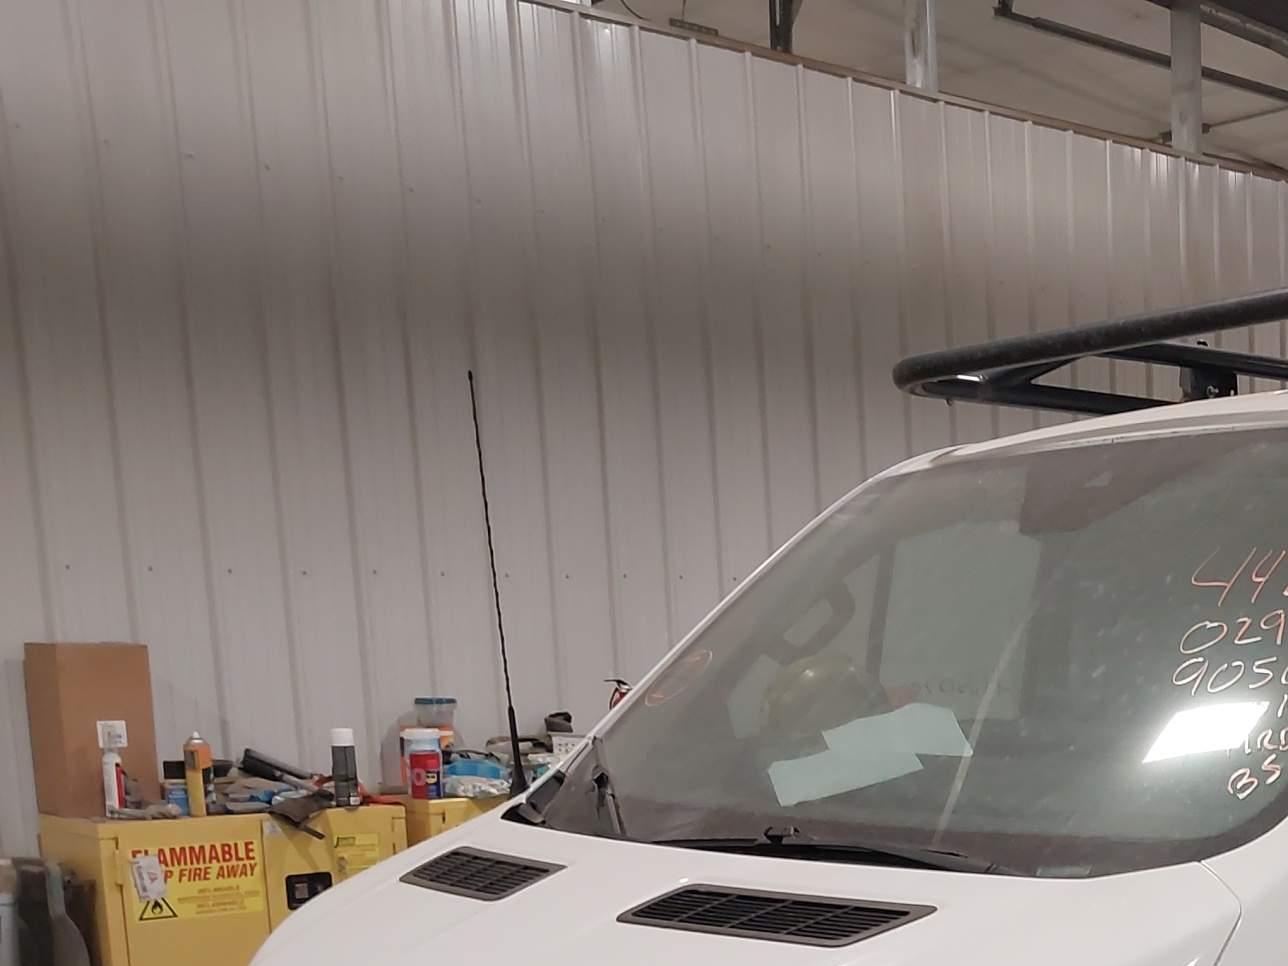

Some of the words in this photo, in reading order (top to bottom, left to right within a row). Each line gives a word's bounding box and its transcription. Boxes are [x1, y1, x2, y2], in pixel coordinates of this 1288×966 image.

[131, 840, 256, 868] AMMABLE
[178, 866, 212, 883] FIRE
[216, 861, 258, 881] AWAY
